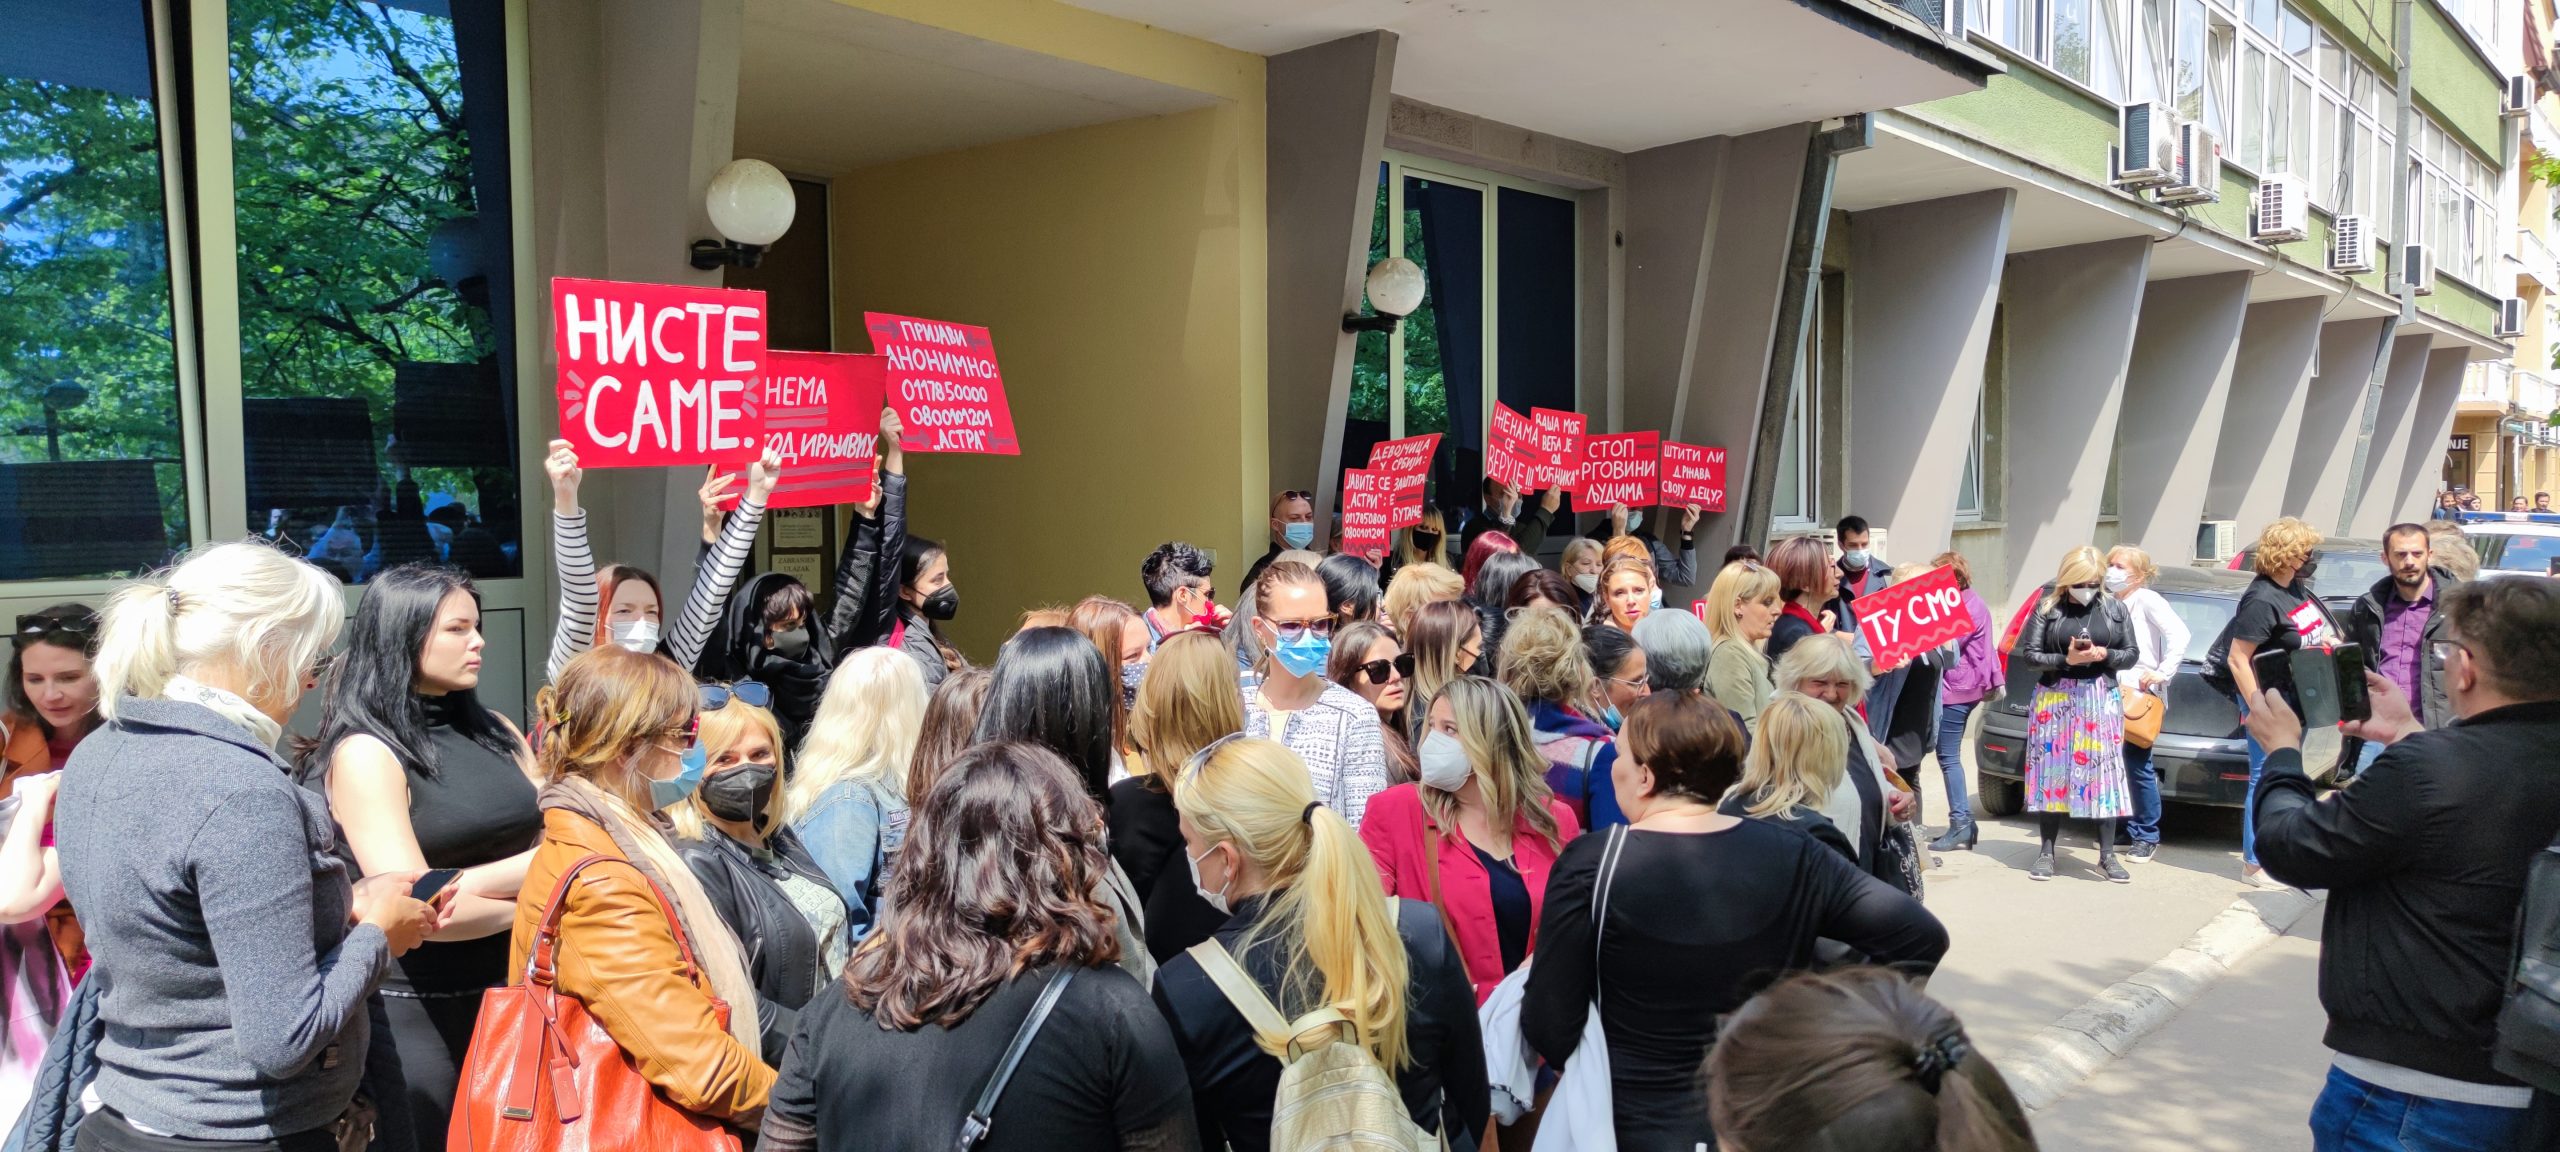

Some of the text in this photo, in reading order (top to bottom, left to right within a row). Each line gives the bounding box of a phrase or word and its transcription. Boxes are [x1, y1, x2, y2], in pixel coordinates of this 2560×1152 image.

[565, 294, 760, 371] НИСТЕ
[900, 320, 967, 347] ПРИЈАВИ
[886, 344, 998, 379] АНОНИМНО:
[765, 376, 828, 406] НЕМА
[901, 379, 988, 403] 0117850000
[585, 375, 755, 454] САМЕ.
[1369, 438, 1431, 464] ДЕВОЈЧИЦА
[1504, 437, 1515, 453] СЕ
[1588, 438, 1634, 458] СТОП
[1664, 444, 1724, 464] ШТИТИ ЛИ
[2448, 439, 2469, 450] NJE
[1346, 473, 1391, 490] ЈАВИТЕ СЕ
[1582, 460, 1656, 481] РГОВИНИ
[1672, 465, 1711, 480] ДРЖАВА
[1586, 482, 1644, 504] ЉУДИМА
[1662, 480, 1723, 505] СВОЈУ ДЕЦУ?
[1908, 587, 1961, 625] СМО
